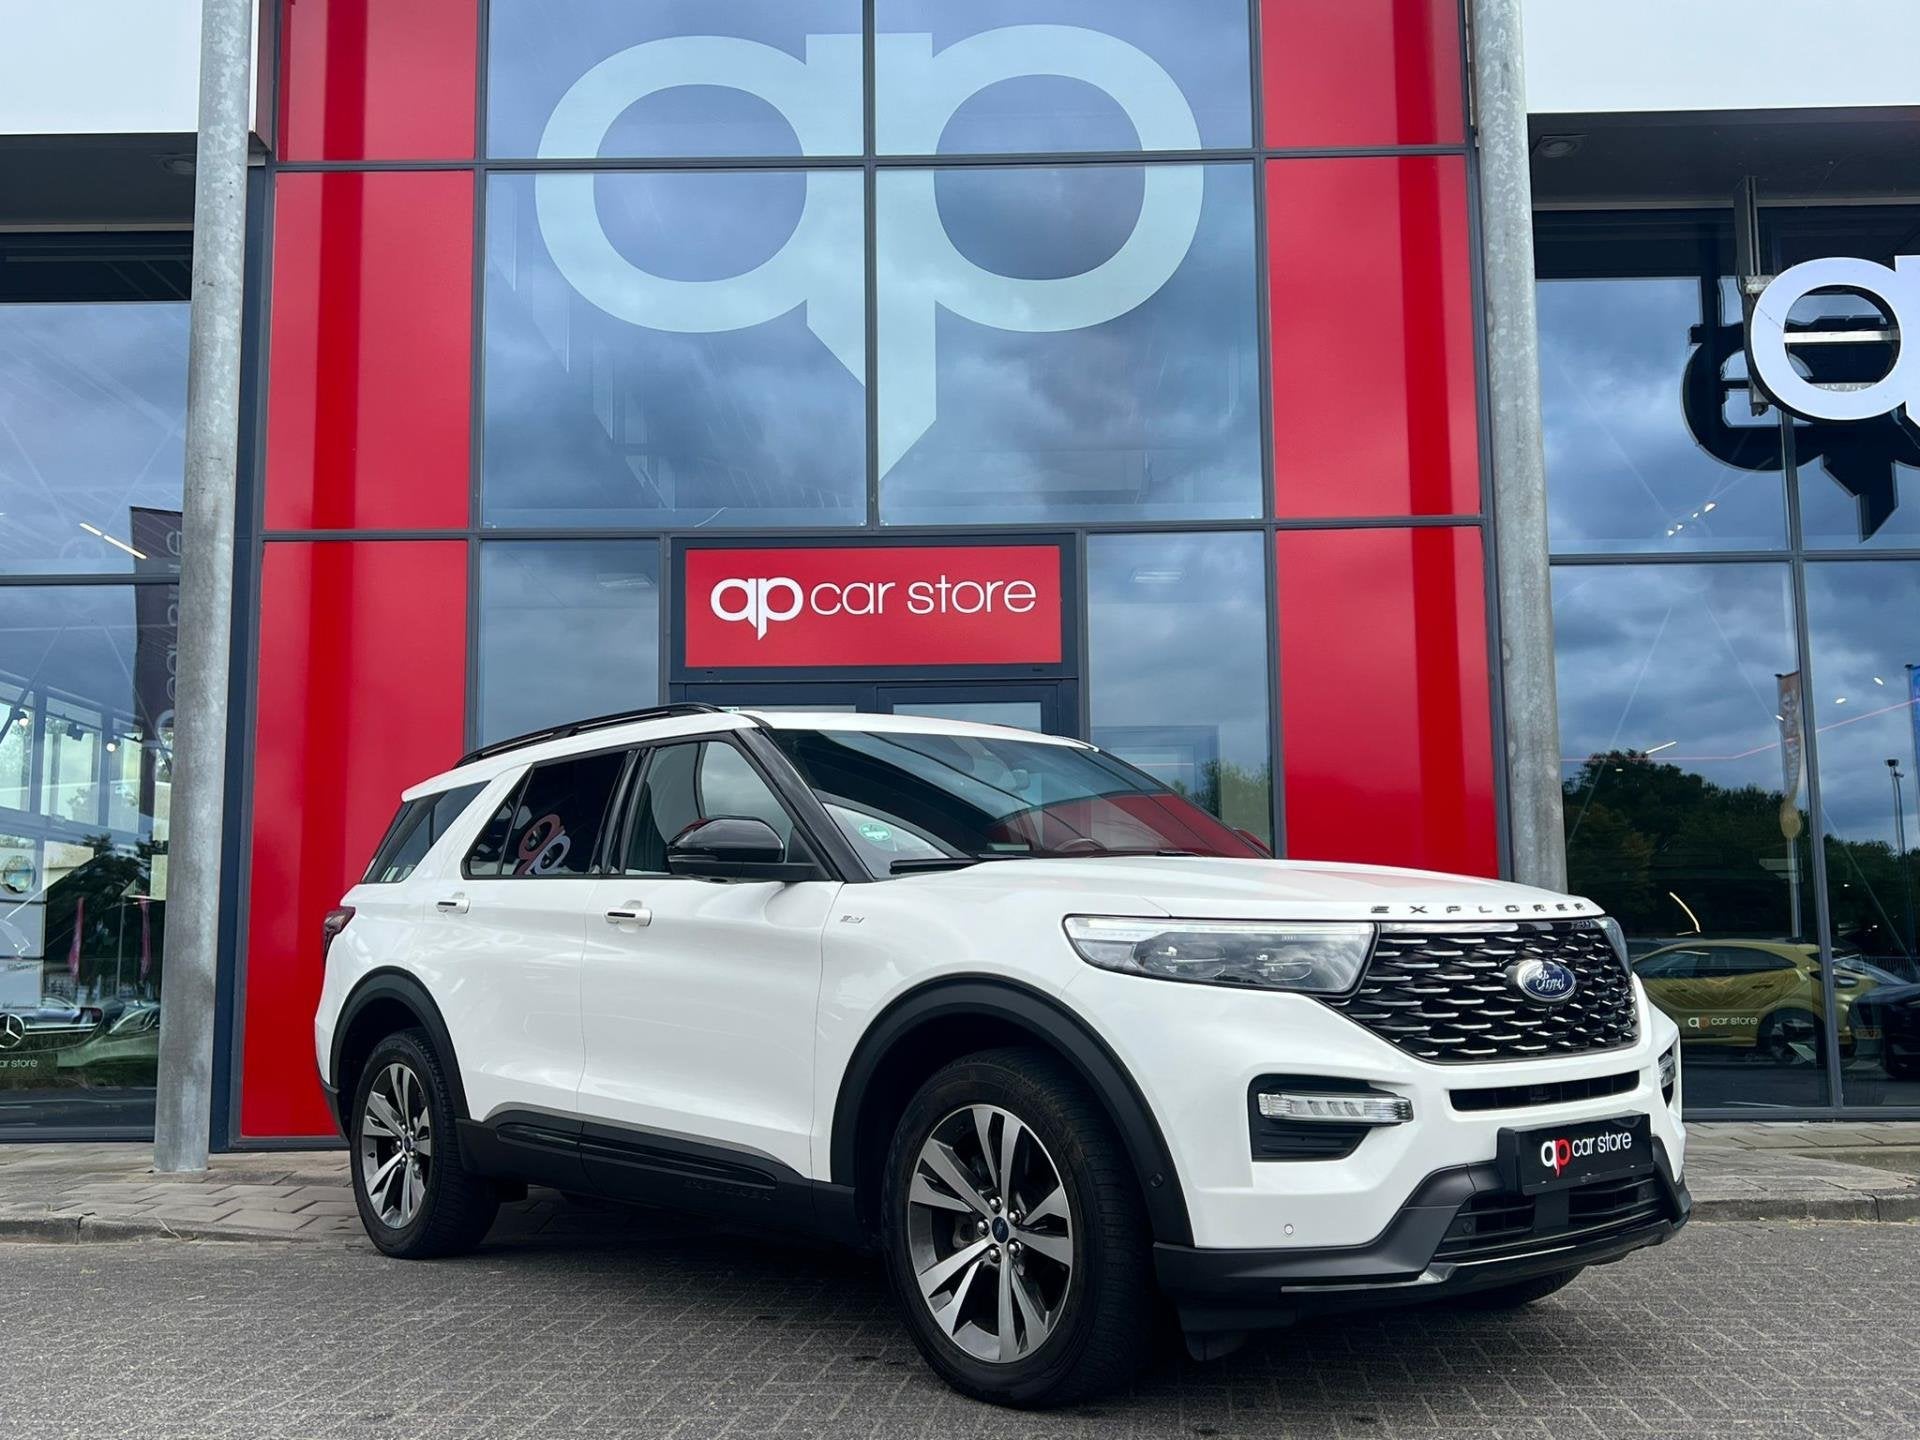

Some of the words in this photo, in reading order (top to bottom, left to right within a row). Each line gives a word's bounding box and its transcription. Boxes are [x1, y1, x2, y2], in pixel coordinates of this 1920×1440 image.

[710, 576, 804, 640] ap
[810, 581, 896, 615] car
[907, 574, 1037, 615] store
[1371, 902, 1586, 914] EXPLORER
[1535, 968, 1566, 991] Ford
[1711, 1016, 1729, 1026] car
[1731, 1015, 1759, 1026] store
[11, 1058, 38, 1068] store
[1541, 1139, 1571, 1177] ap
[1572, 1137, 1595, 1157] car
[1598, 1131, 1632, 1153] store
